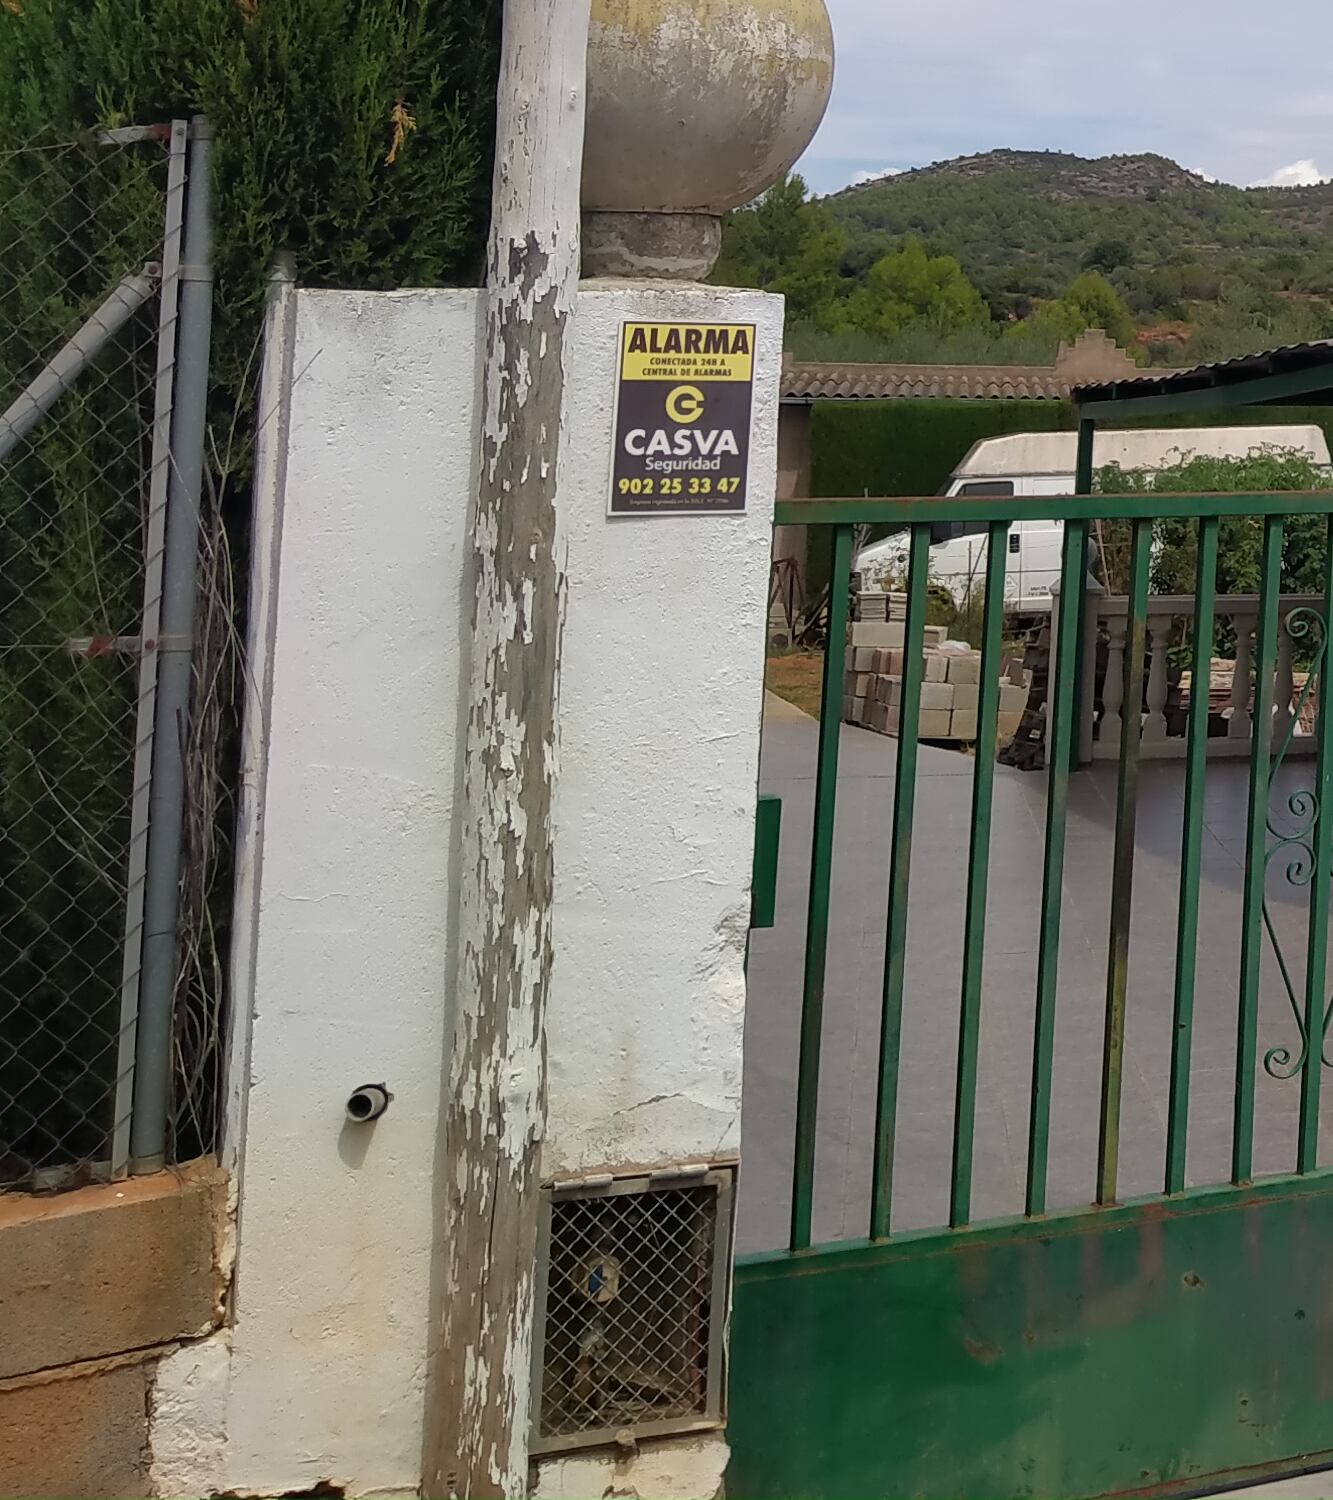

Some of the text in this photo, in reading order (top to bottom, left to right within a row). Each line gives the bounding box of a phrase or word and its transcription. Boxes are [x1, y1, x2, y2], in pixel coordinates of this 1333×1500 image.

[627, 328, 750, 355] ALARMA
[650, 357, 726, 366] CONECTADA 24H A
[642, 368, 732, 376] CENTRAL DE ALARMAS
[624, 428, 740, 456] CASVA
[645, 456, 721, 474] Seguridad
[618, 477, 741, 495] 902 25 33 47
